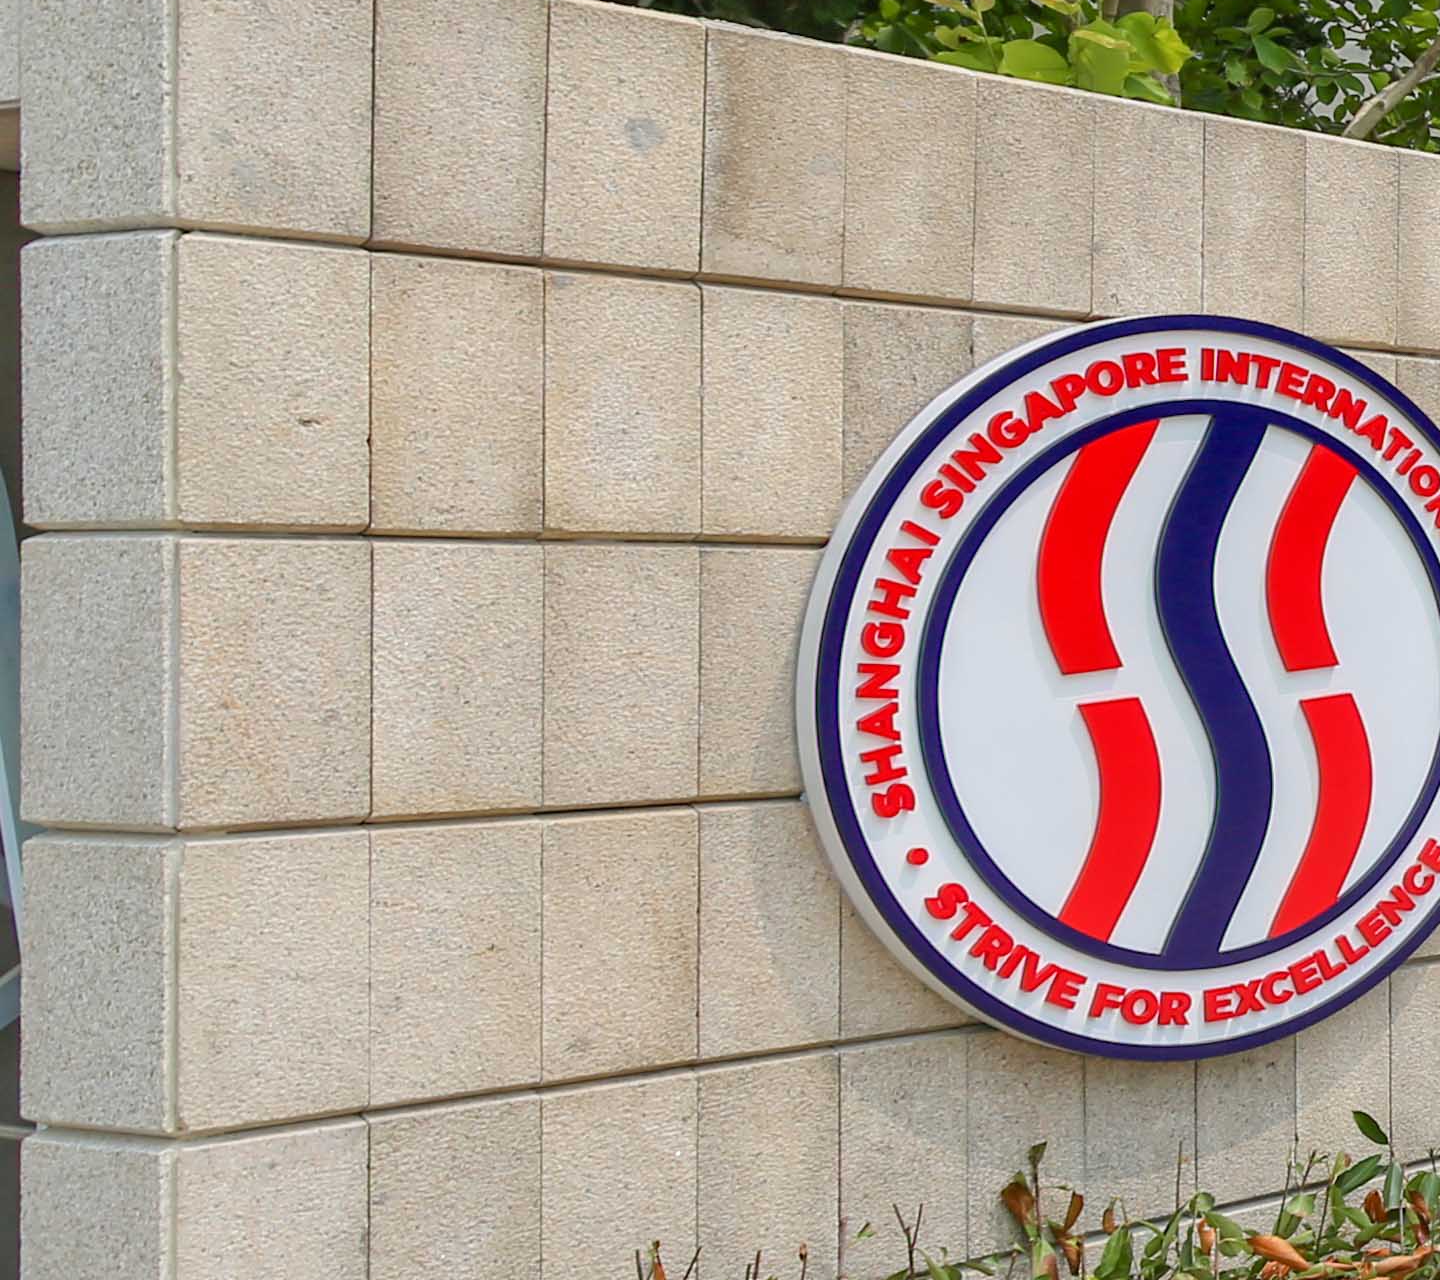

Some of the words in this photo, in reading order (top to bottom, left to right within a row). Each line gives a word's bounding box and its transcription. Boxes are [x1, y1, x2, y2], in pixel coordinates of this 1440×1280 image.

[857, 520, 941, 820] SHANGHAI
[921, 347, 1189, 520] SINGAPORE
[924, 882, 1088, 1011] STRIVE
[1090, 982, 1193, 1027] FOR
